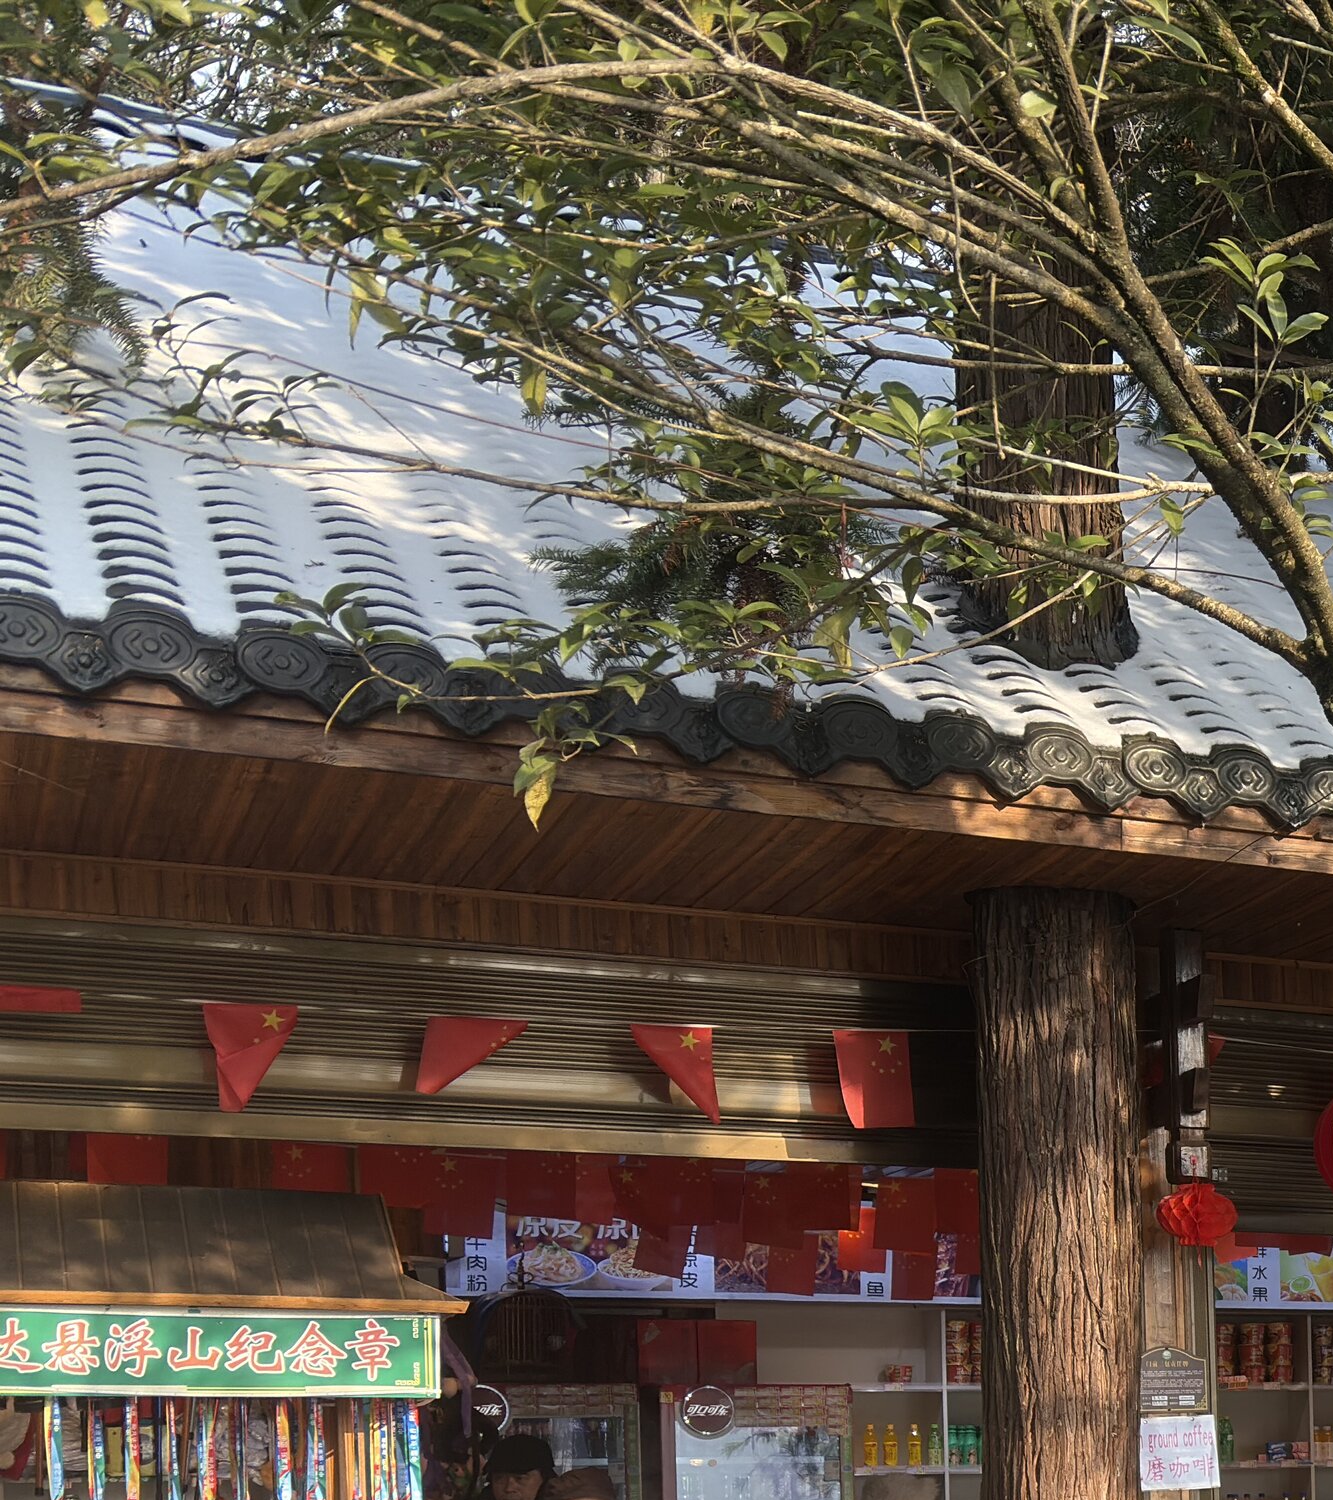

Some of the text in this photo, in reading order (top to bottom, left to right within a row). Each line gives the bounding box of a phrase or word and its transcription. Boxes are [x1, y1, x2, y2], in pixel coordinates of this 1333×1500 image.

[687, 1403, 729, 1417] 可口可乐
[1148, 1427, 1179, 1453] ground
[1182, 1425, 1214, 1447] coffee
